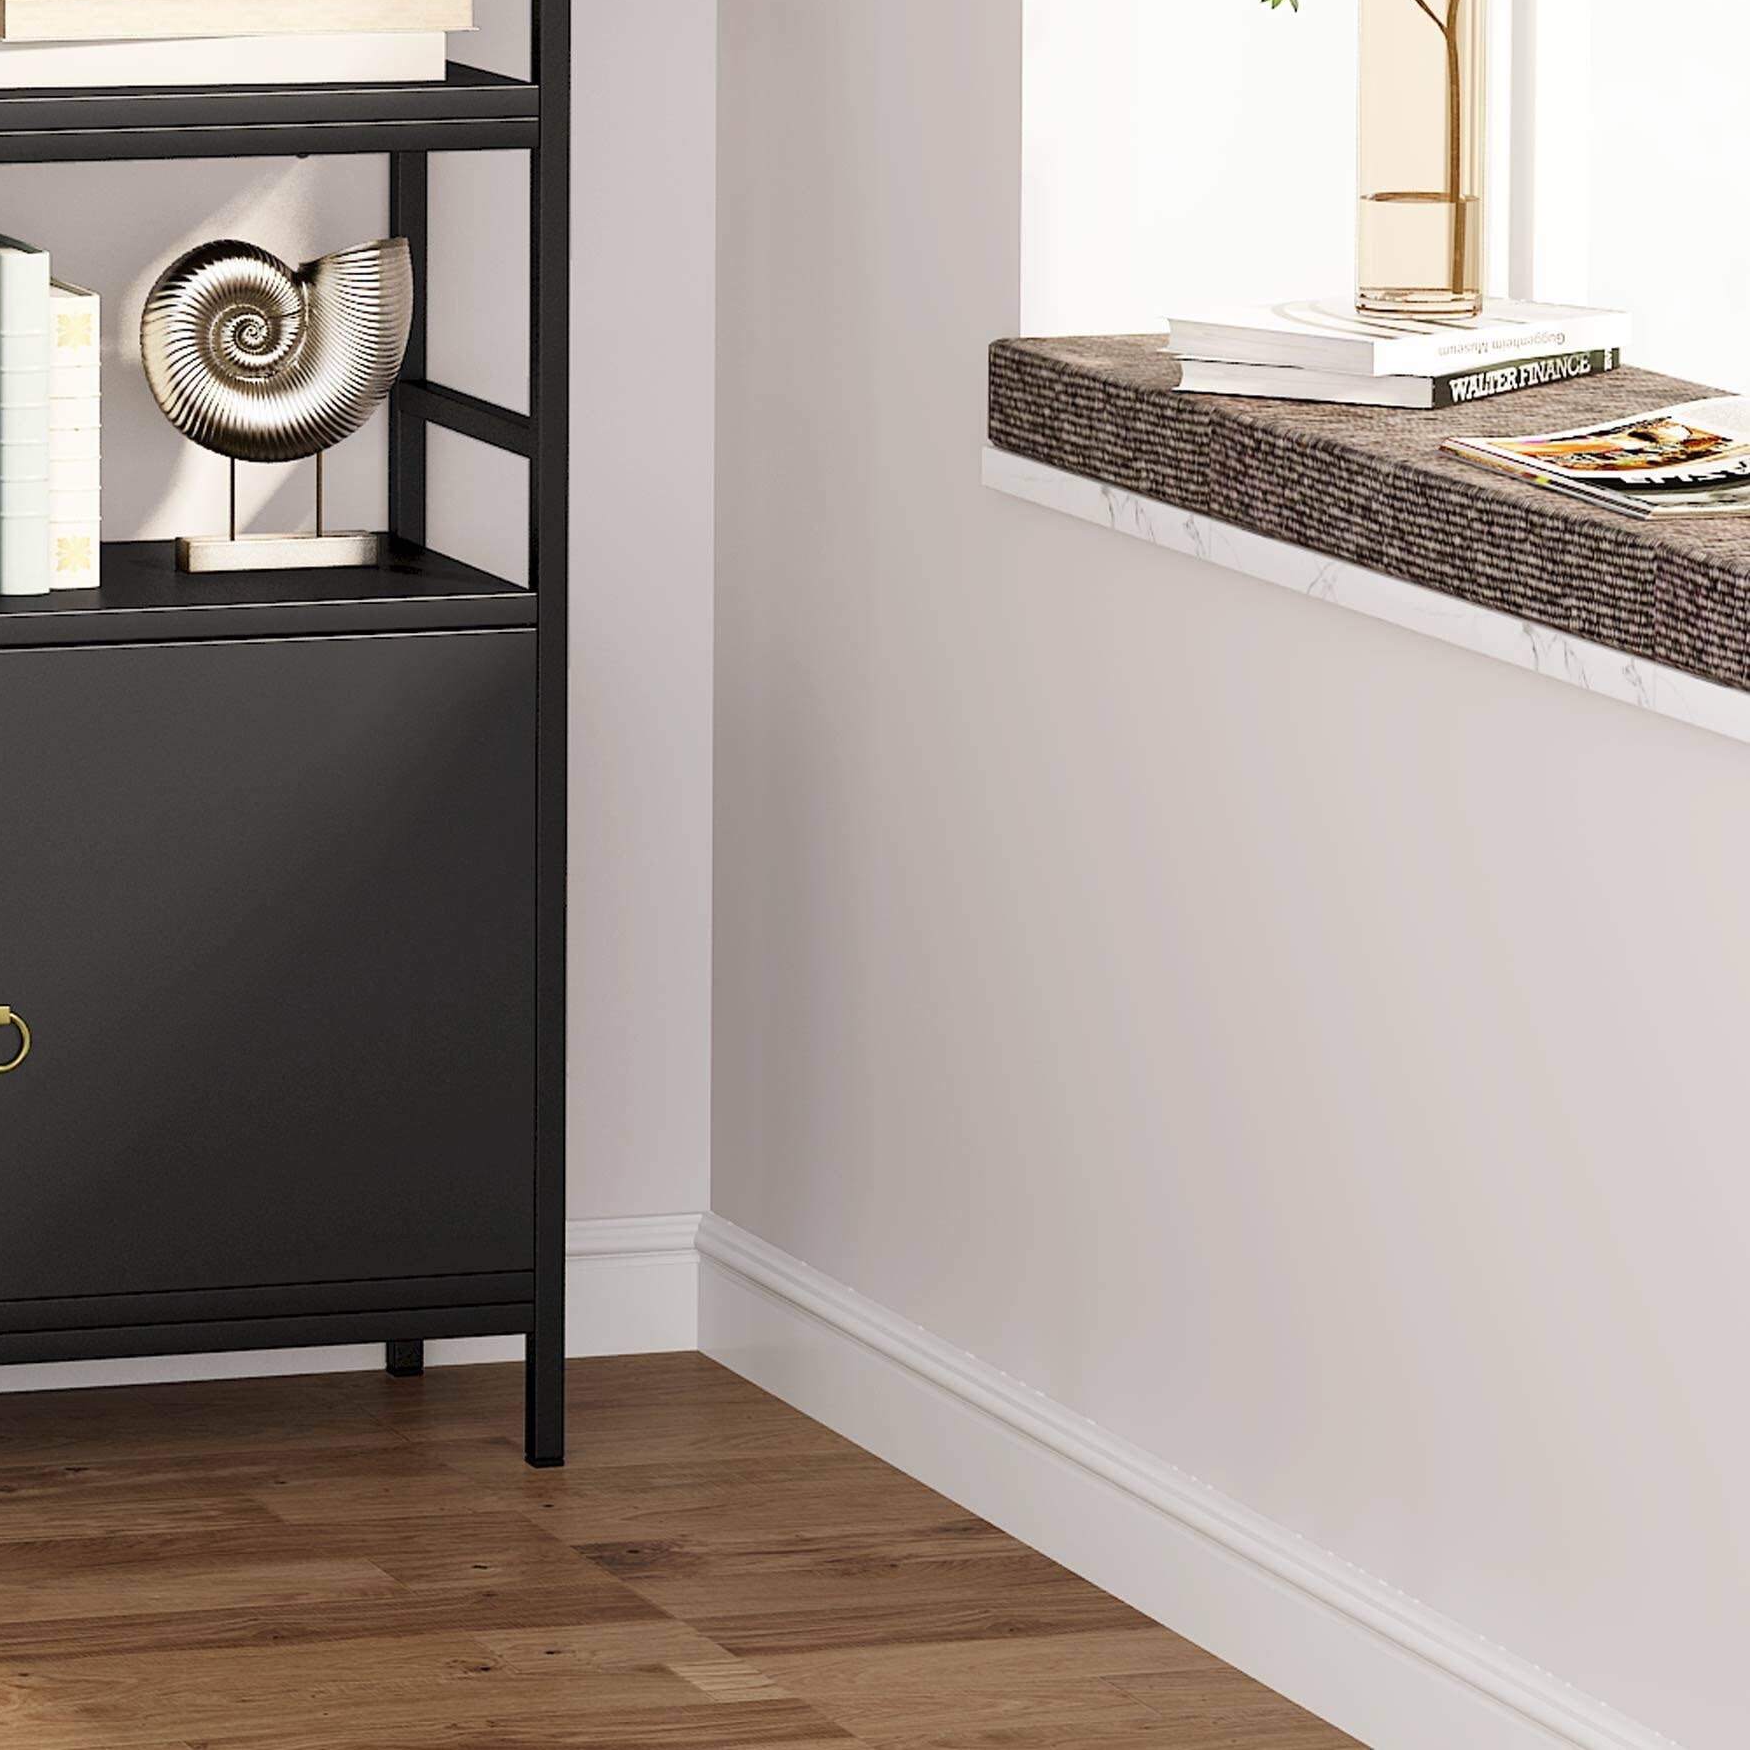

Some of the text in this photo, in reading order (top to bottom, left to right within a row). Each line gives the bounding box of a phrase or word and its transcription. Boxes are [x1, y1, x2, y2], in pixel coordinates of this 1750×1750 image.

[1438, 331, 1566, 357] Guggenheim Museum
[1448, 366, 1519, 403] WALTER
[1519, 352, 1592, 387] FINANCE
